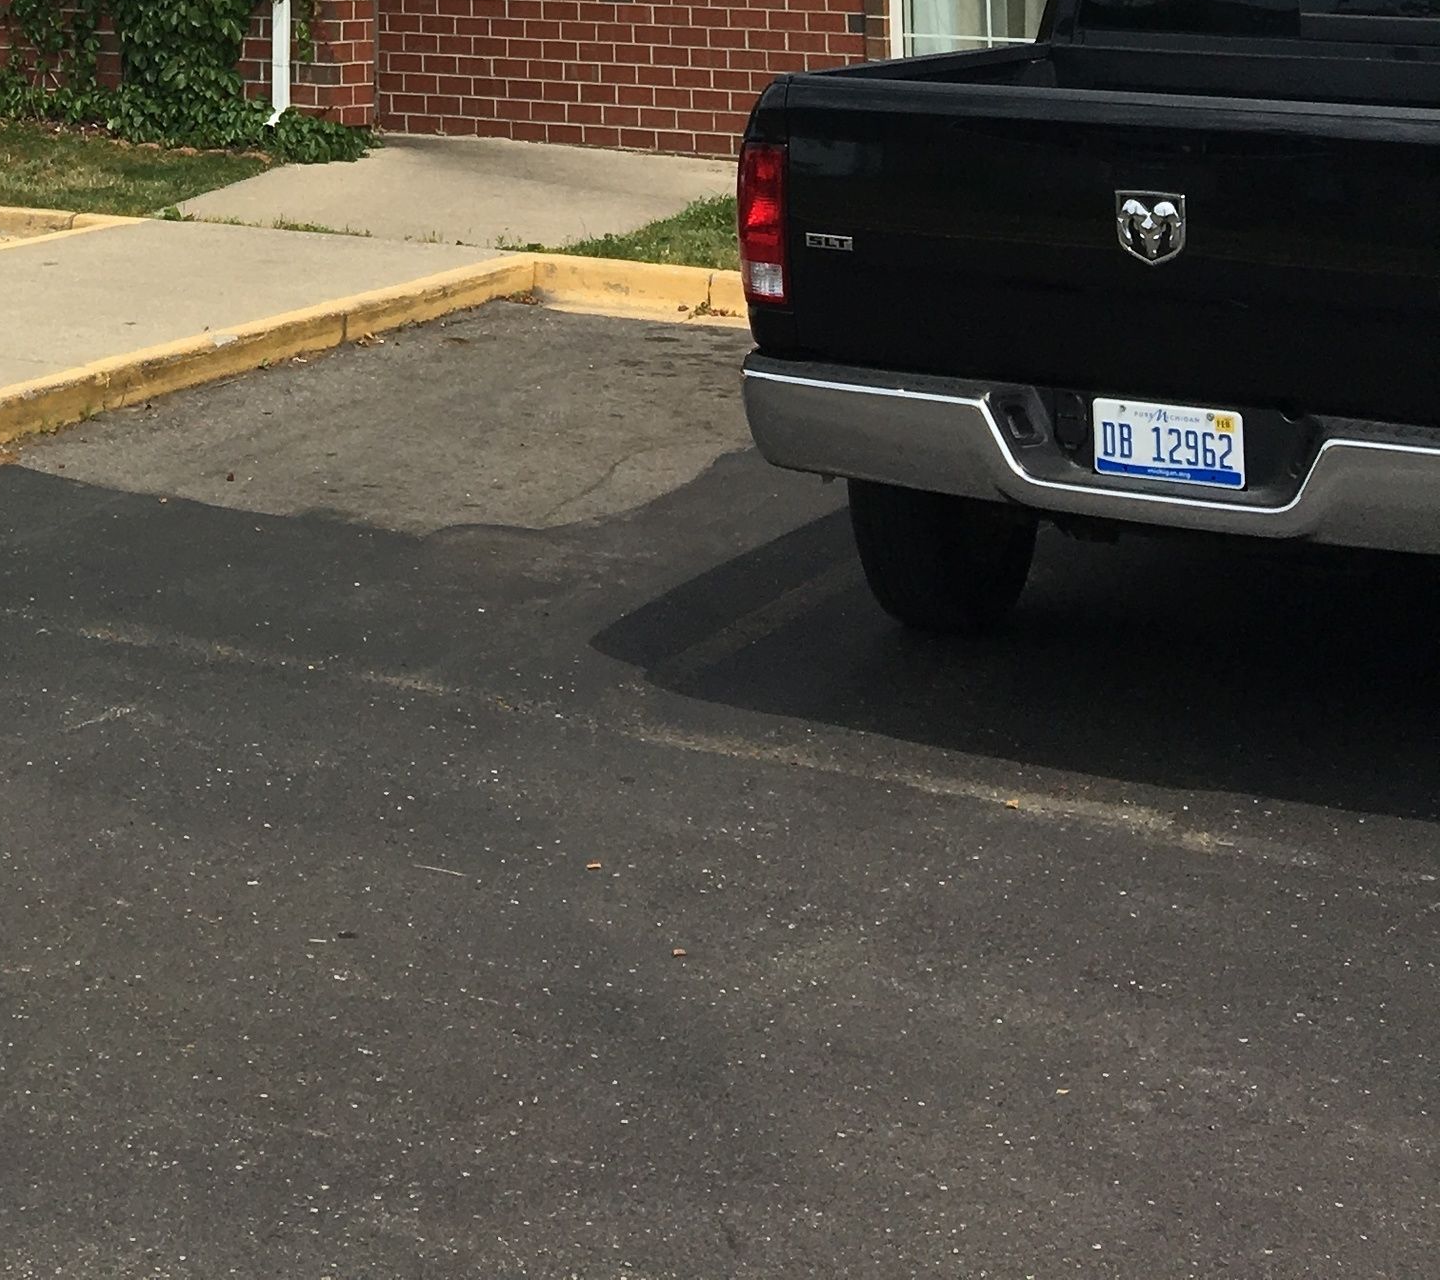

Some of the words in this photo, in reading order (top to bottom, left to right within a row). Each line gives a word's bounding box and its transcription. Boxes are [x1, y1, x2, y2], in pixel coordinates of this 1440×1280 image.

[808, 235, 850, 249] SLT
[1102, 421, 1132, 458] DB
[1152, 426, 1233, 470] 12962
